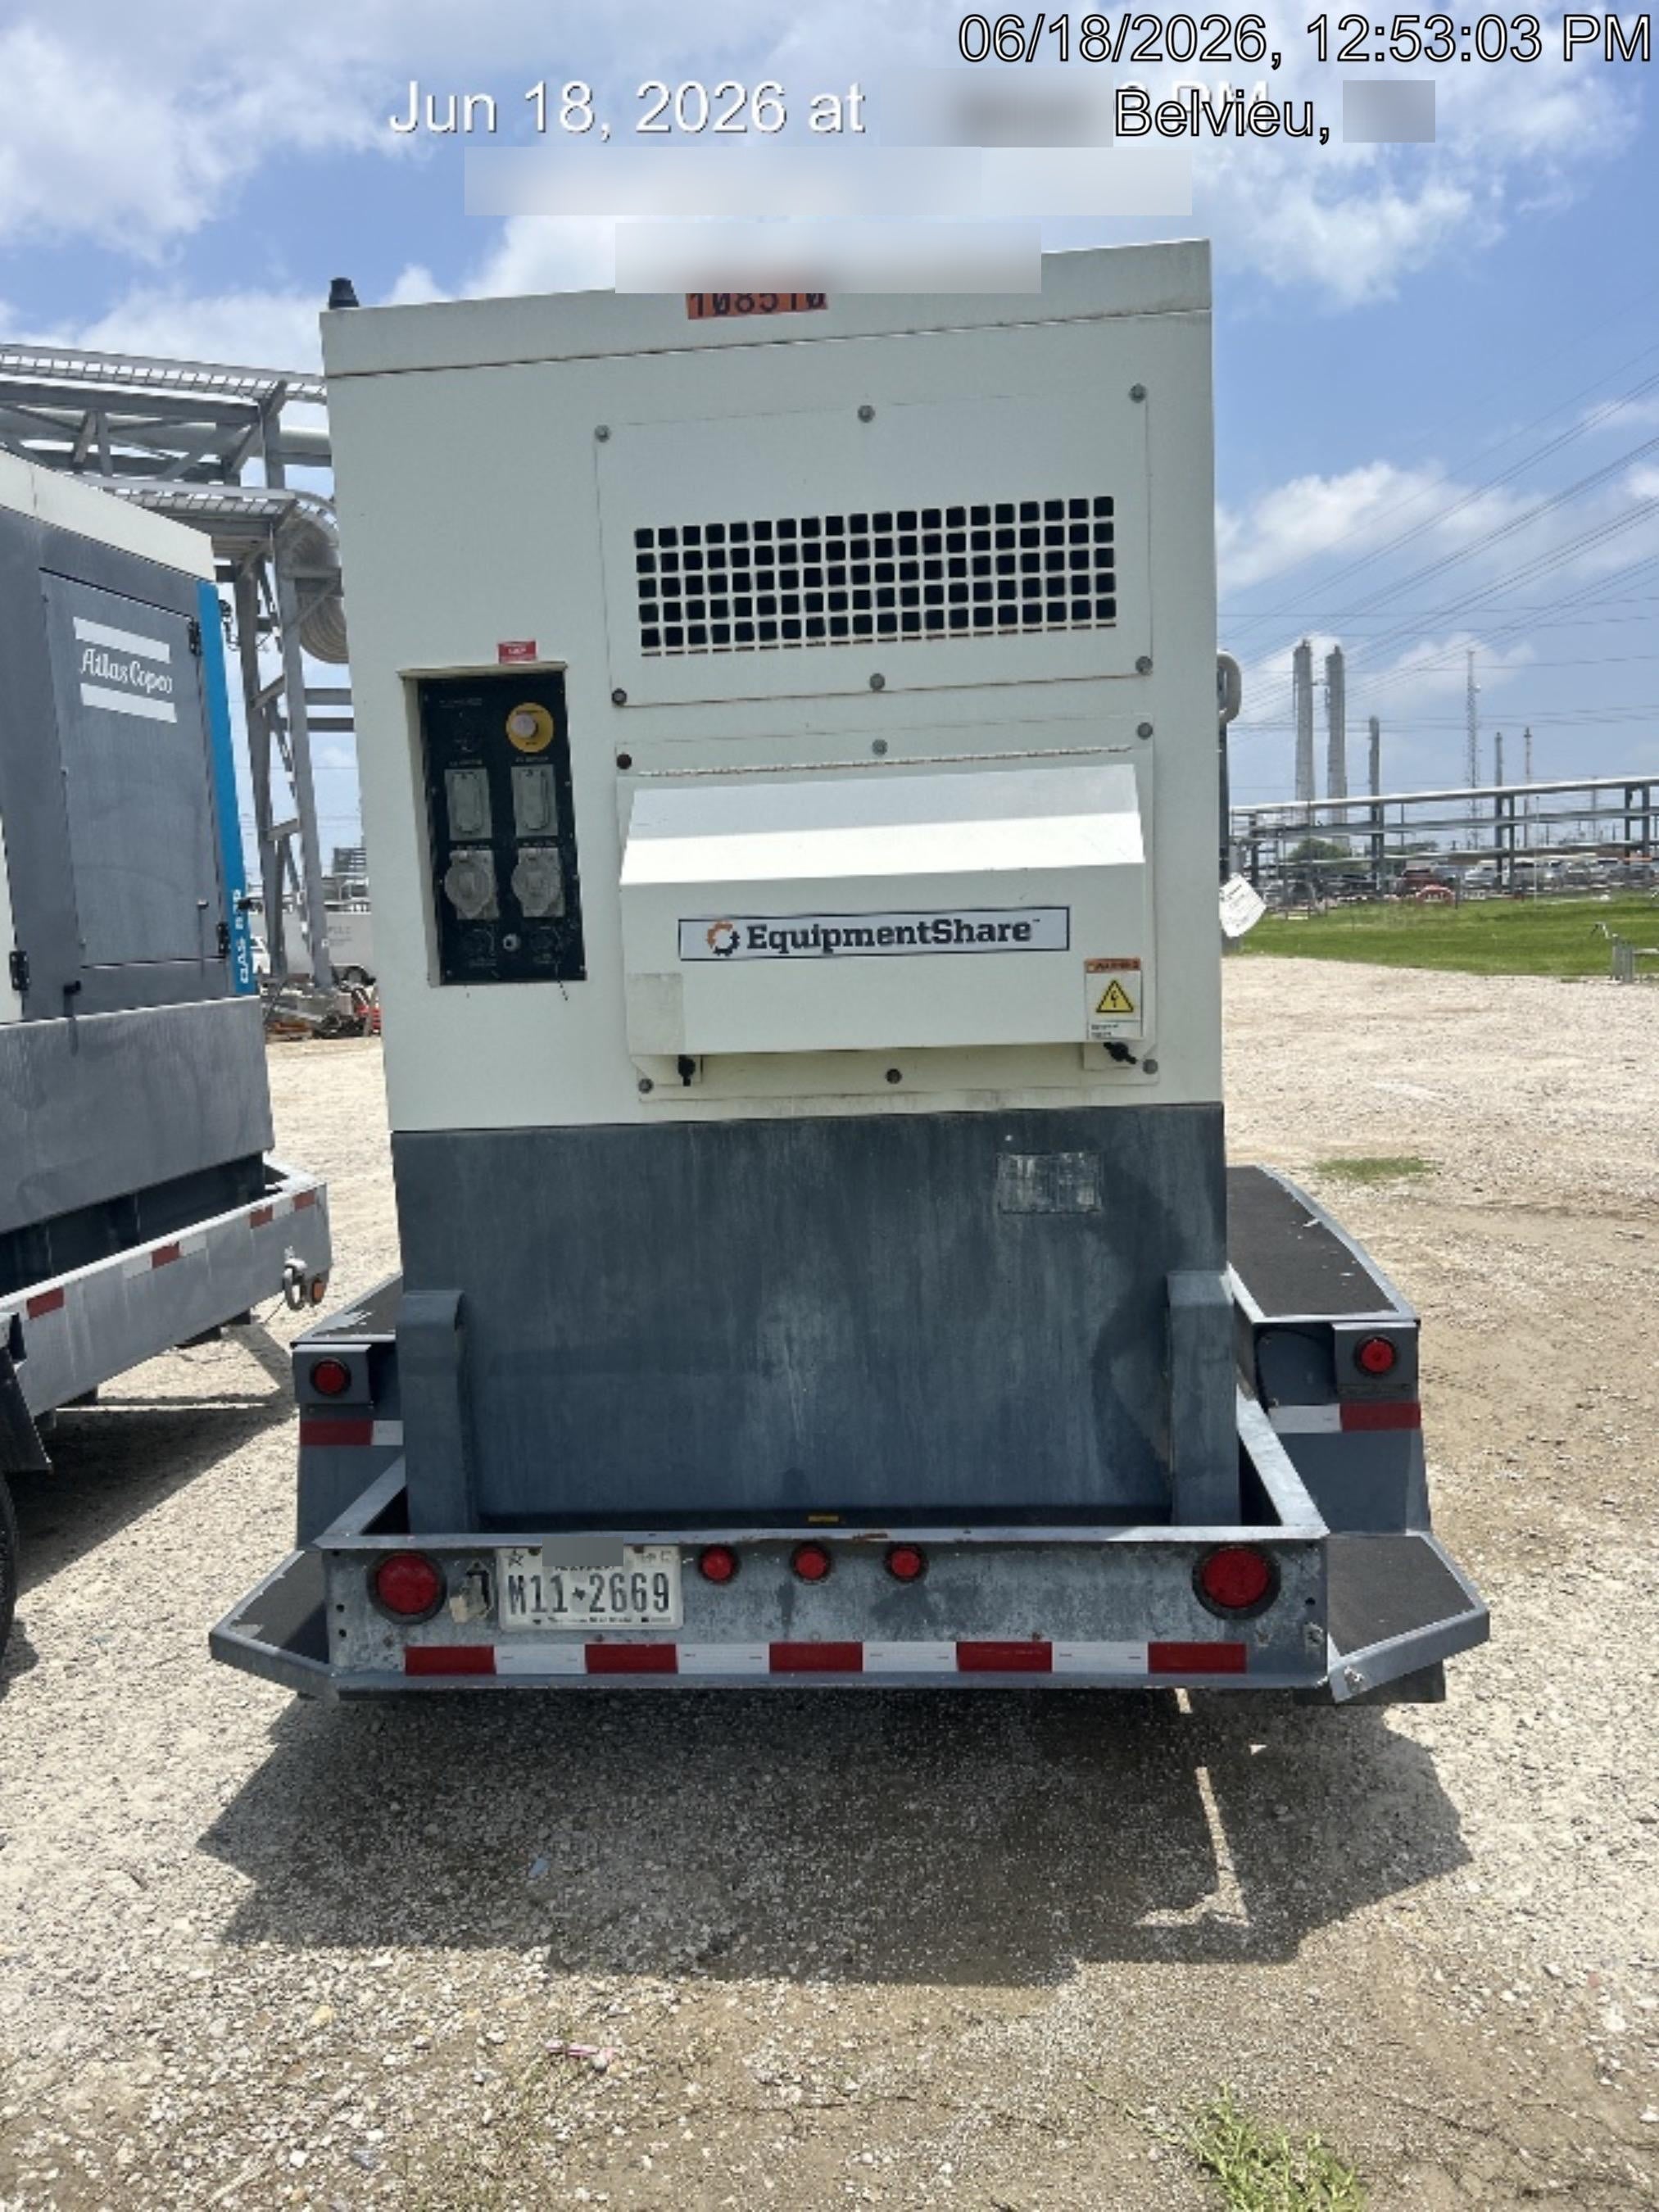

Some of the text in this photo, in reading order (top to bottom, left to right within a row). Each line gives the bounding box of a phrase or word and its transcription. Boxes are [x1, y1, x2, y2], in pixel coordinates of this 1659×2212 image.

[79, 648, 173, 694] Atlas Copco
[746, 918, 1032, 956] EquipmentShare
